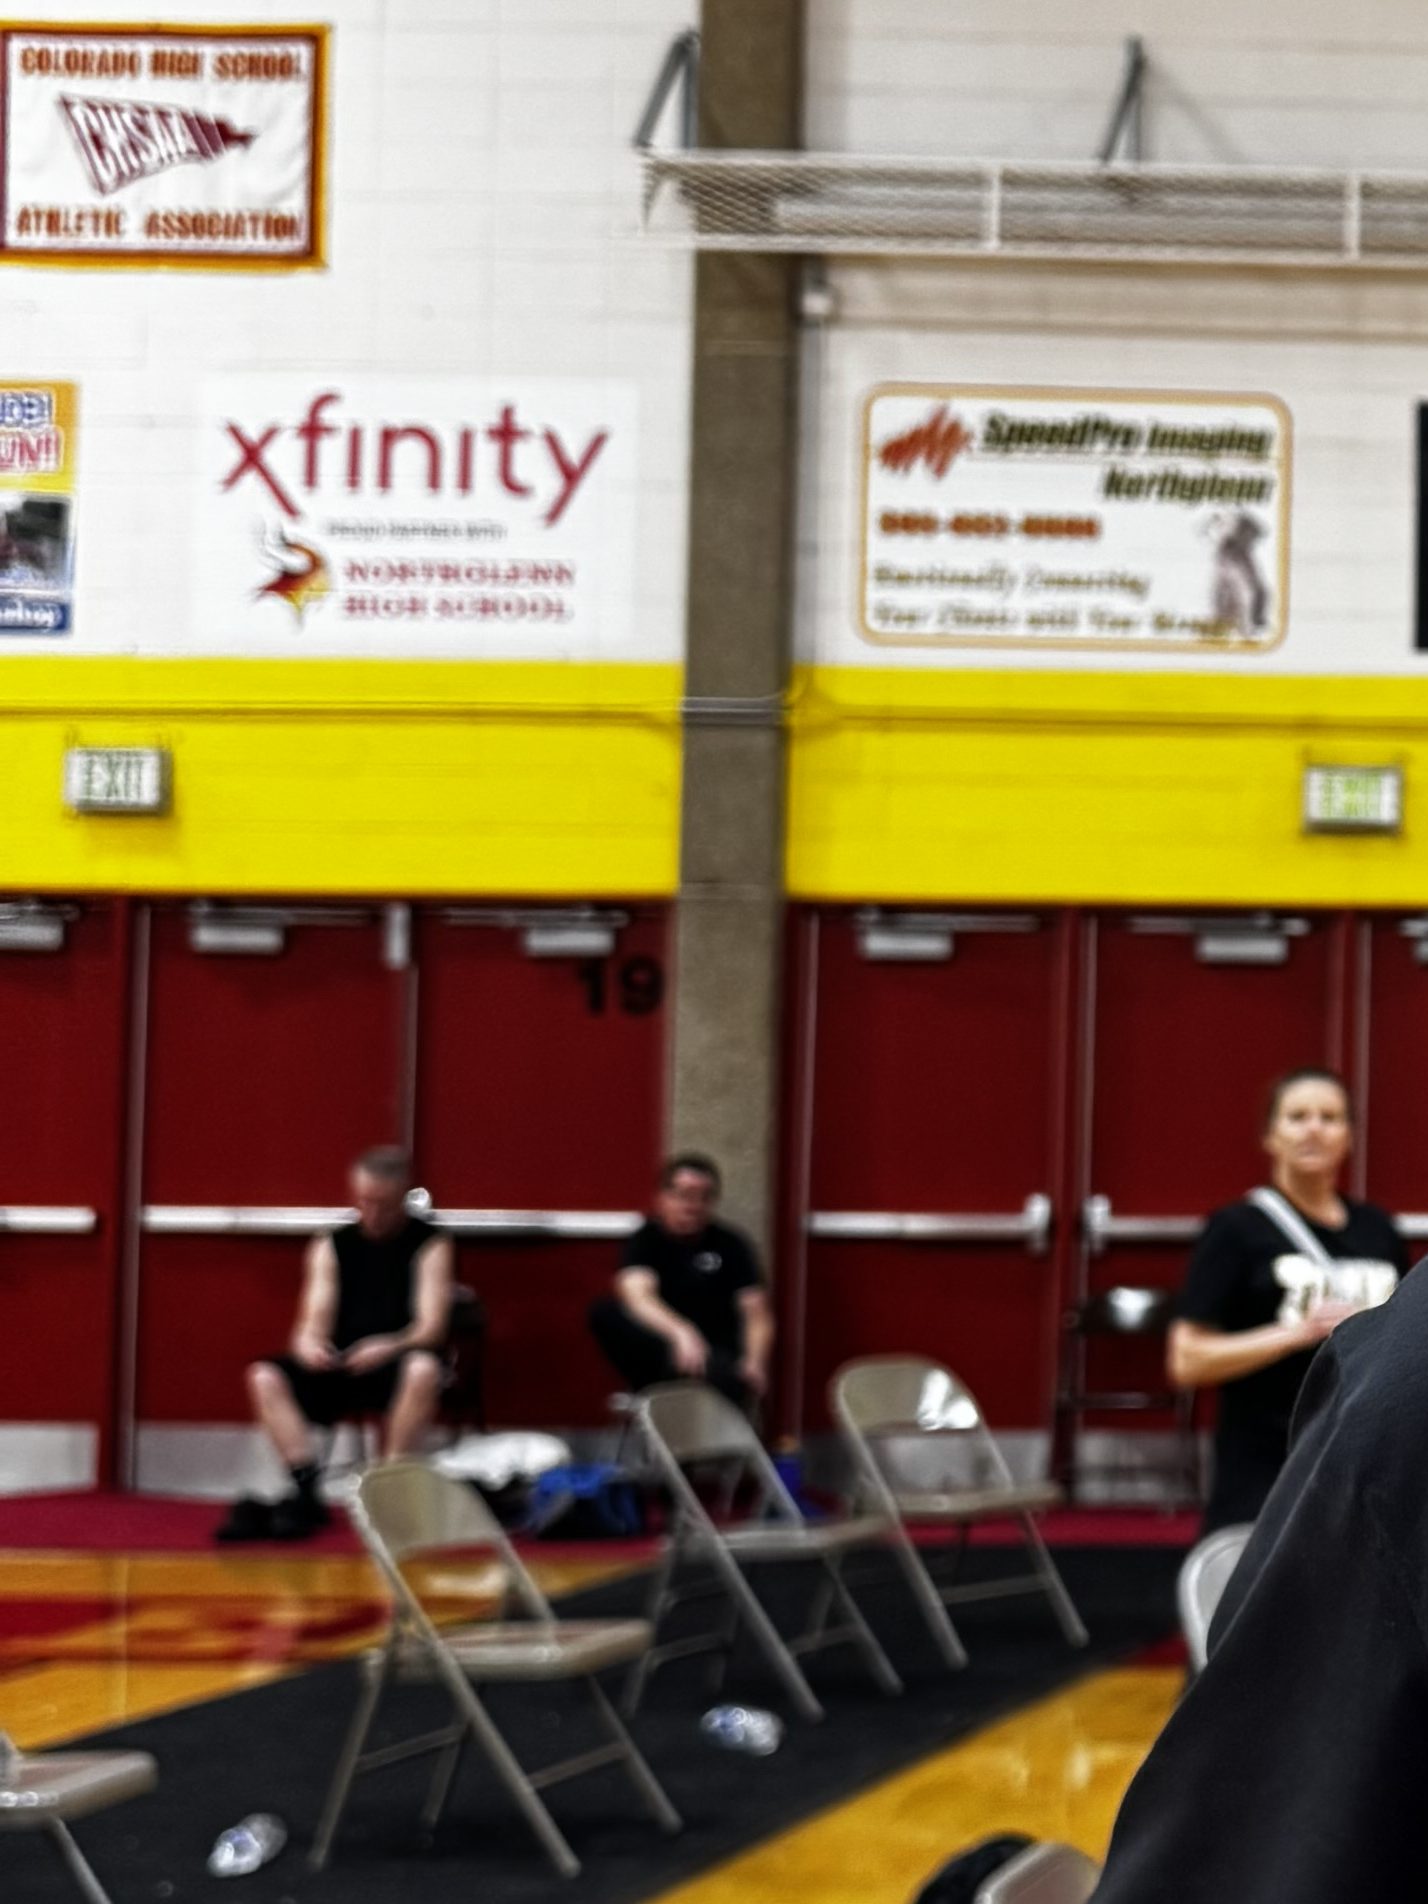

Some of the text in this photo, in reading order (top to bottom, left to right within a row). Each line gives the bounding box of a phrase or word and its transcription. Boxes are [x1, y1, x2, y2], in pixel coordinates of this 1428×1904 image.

[20, 47, 301, 82] COLORADO HIGH SCHOOL
[17, 206, 298, 241] ATHLETIC ASSOCIATION
[222, 392, 608, 528] xfinity
[83, 755, 143, 799] EXIT
[578, 955, 665, 1016] 19
